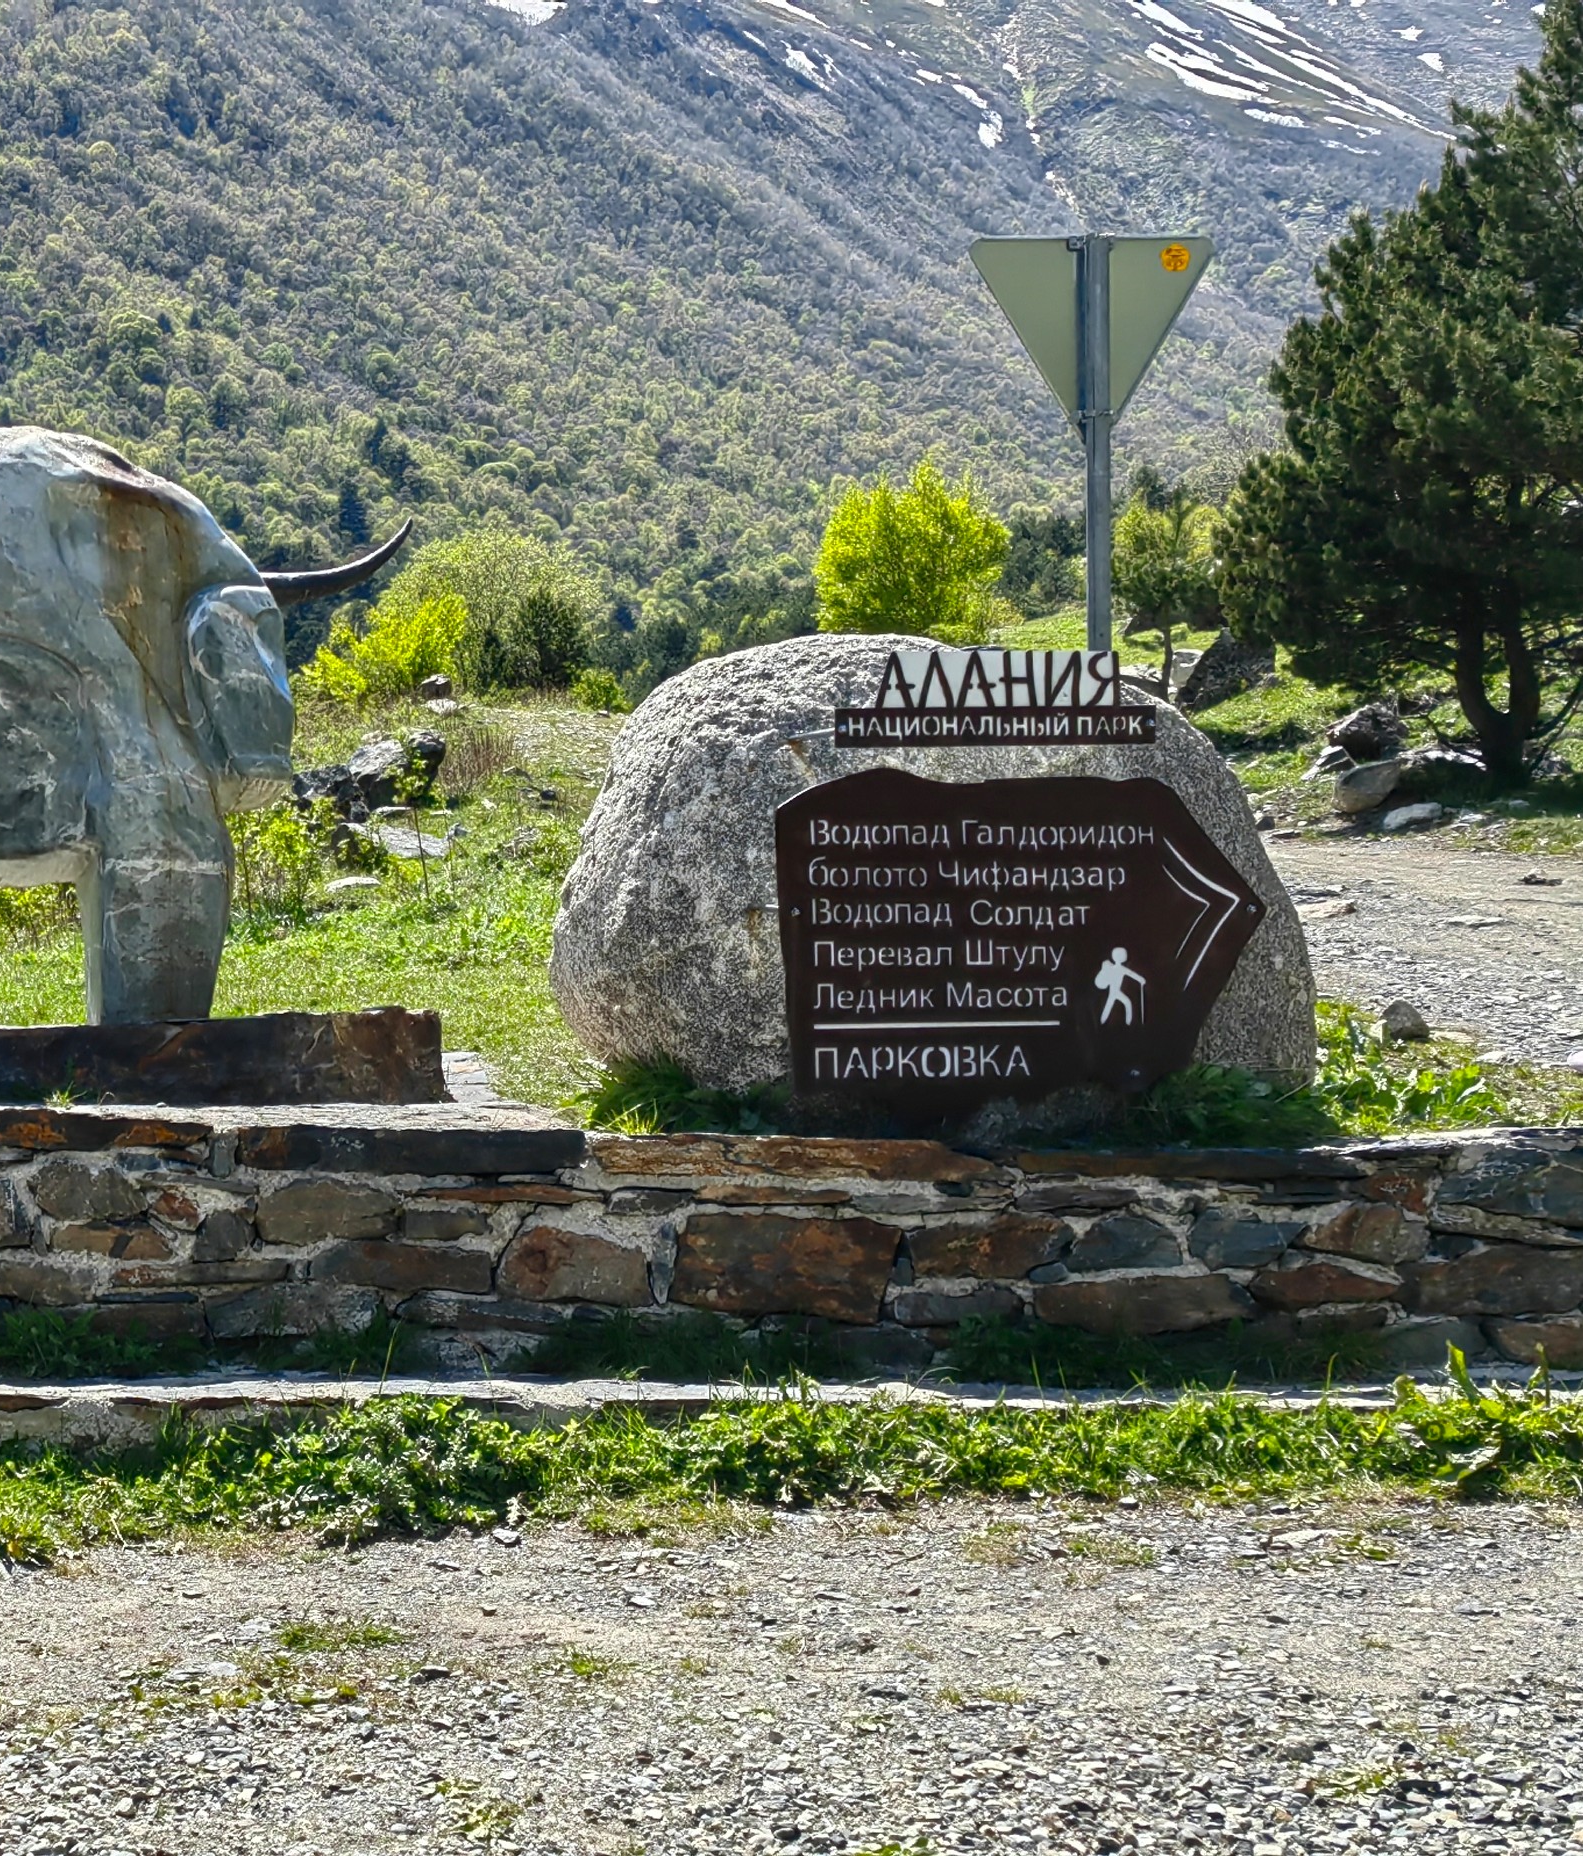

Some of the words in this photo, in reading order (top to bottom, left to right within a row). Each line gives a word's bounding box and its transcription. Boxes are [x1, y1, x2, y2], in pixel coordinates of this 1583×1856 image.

[875, 650, 1118, 706] АЛАНИЯ
[848, 712, 1069, 740] НАЦИОНАЛЬНЫЙ
[1077, 715, 1143, 736] ПАРК
[810, 819, 950, 849] Водопад
[961, 819, 1154, 851] Галдоридон
[808, 856, 928, 887] болото
[938, 861, 1126, 892] Чифандзар
[811, 898, 953, 928] Водопад
[970, 899, 1089, 931] Солдат
[814, 940, 952, 972] Перевал
[965, 939, 1065, 972] Штулу
[813, 983, 934, 1014] Ледник
[946, 981, 1068, 1009] Масота
[814, 1044, 1030, 1079] ПАРКОВКА
